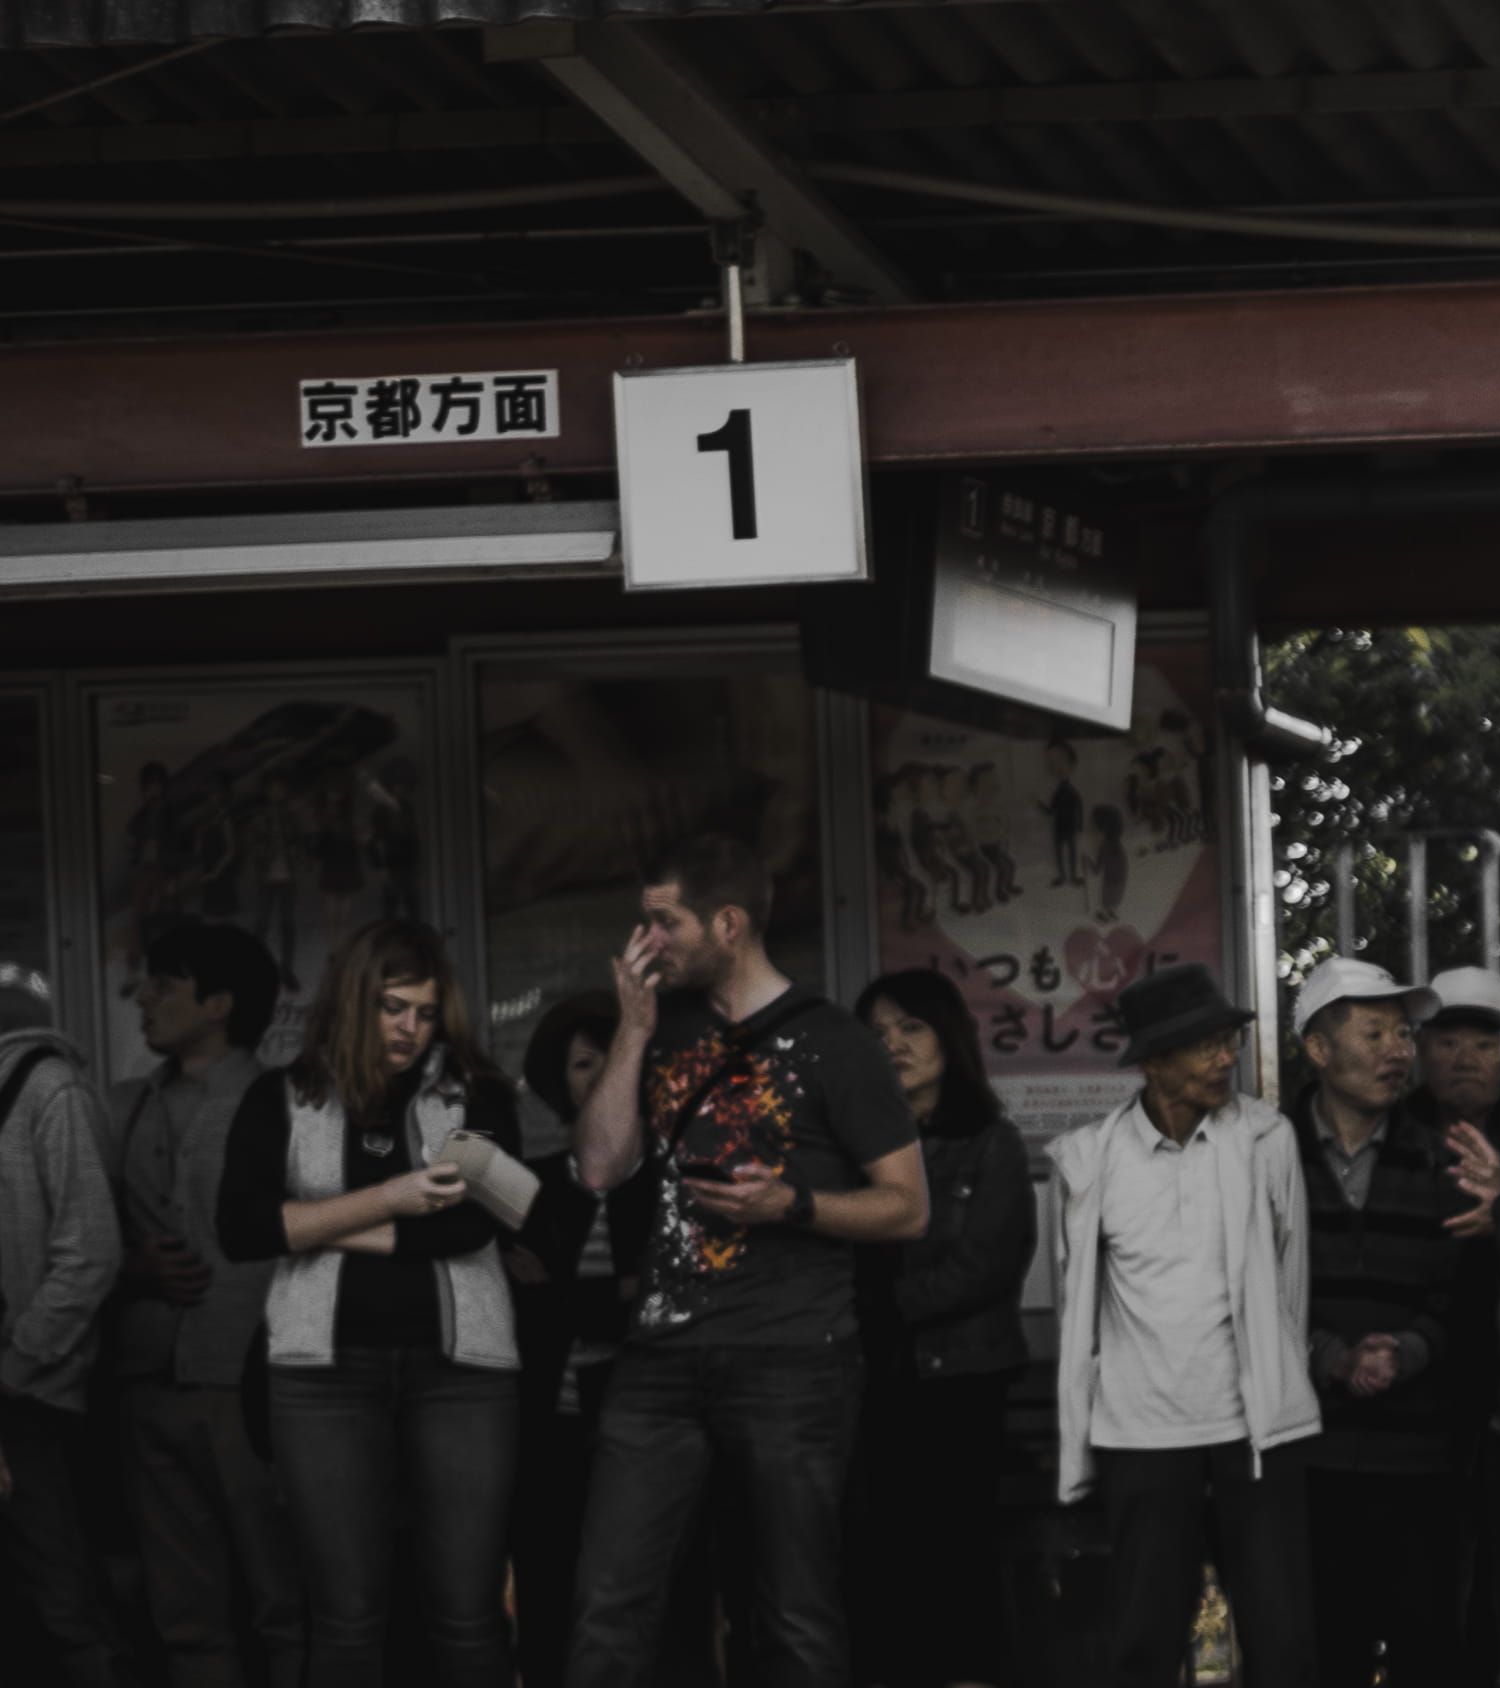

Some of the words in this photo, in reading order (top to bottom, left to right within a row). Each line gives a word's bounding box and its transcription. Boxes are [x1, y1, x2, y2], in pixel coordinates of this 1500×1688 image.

[303, 375, 548, 442] 京都方面
[696, 408, 759, 541] 1
